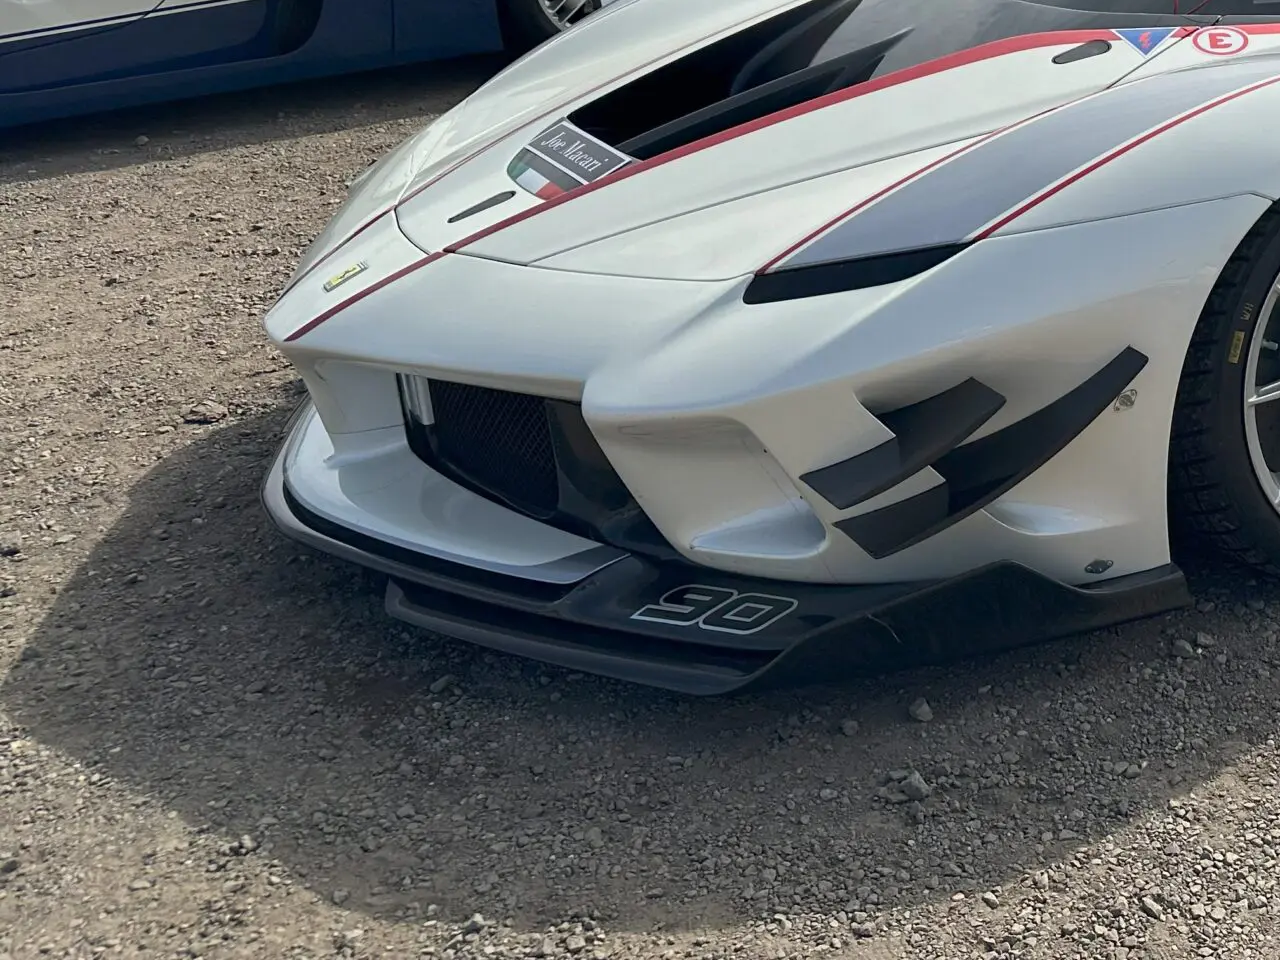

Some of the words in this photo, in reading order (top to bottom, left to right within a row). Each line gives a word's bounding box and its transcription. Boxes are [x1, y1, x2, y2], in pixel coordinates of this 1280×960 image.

[1208, 32, 1233, 49] E
[541, 131, 566, 155] Joe
[560, 140, 609, 172] Macari
[630, 584, 798, 635] 90
